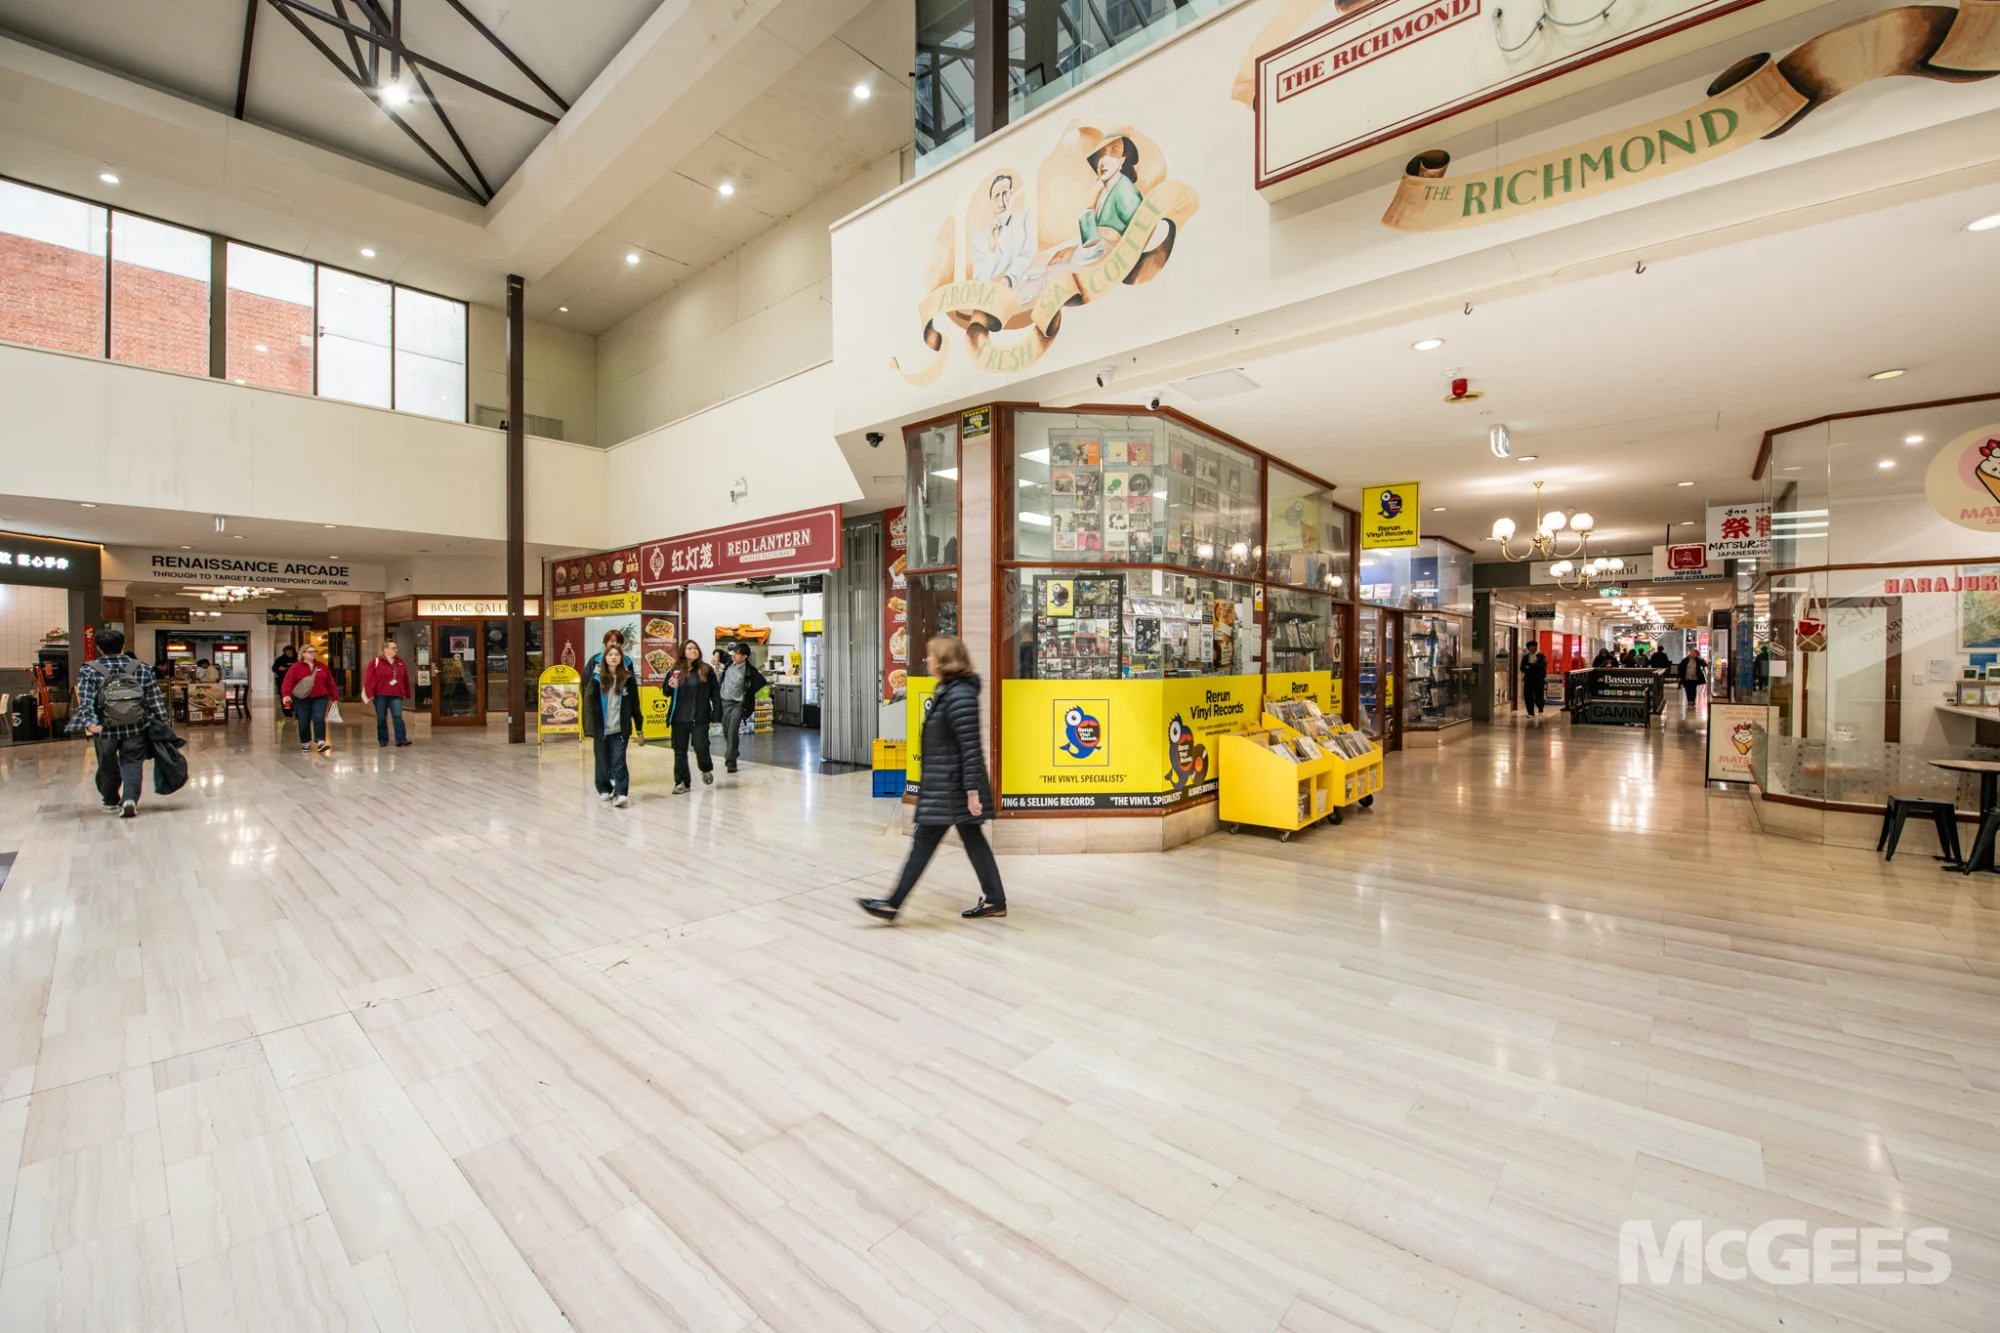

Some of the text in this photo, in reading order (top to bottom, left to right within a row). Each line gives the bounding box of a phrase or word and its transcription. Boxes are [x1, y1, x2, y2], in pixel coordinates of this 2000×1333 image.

[1283, 0, 1471, 92] THE RICHMOND
[1424, 107, 1739, 217] THE RICHMOND
[938, 283, 996, 310] AROMA
[974, 341, 1034, 371] FRESH
[1089, 191, 1165, 293] COFFEE
[1385, 529, 1414, 537] Records
[1721, 516, 1752, 540] 祭
[727, 529, 811, 556] RED LANTERN
[671, 542, 714, 573] 红灯笼
[152, 555, 349, 577] RENAISSANCE ARCADE
[152, 571, 197, 579] THROUGH
[213, 574, 247, 582] TARGET
[256, 577, 310, 585] CENTREPOINT
[578, 603, 588, 611] OFF
[610, 599, 625, 608] USERS
[1292, 682, 1309, 693] Rerun
[1206, 690, 1230, 703] Rerun
[1190, 701, 1244, 720] Vinyl Records
[1719, 756, 1752, 764] MATS
[1039, 774, 1127, 783] "THE VINYL SPECIALISTS"
[1019, 798, 1026, 806] &
[1027, 797, 1059, 806] SELLING
[1060, 796, 1095, 805] RECORDS
[1110, 796, 1129, 806] "THE
[1129, 796, 1151, 806] VINYL
